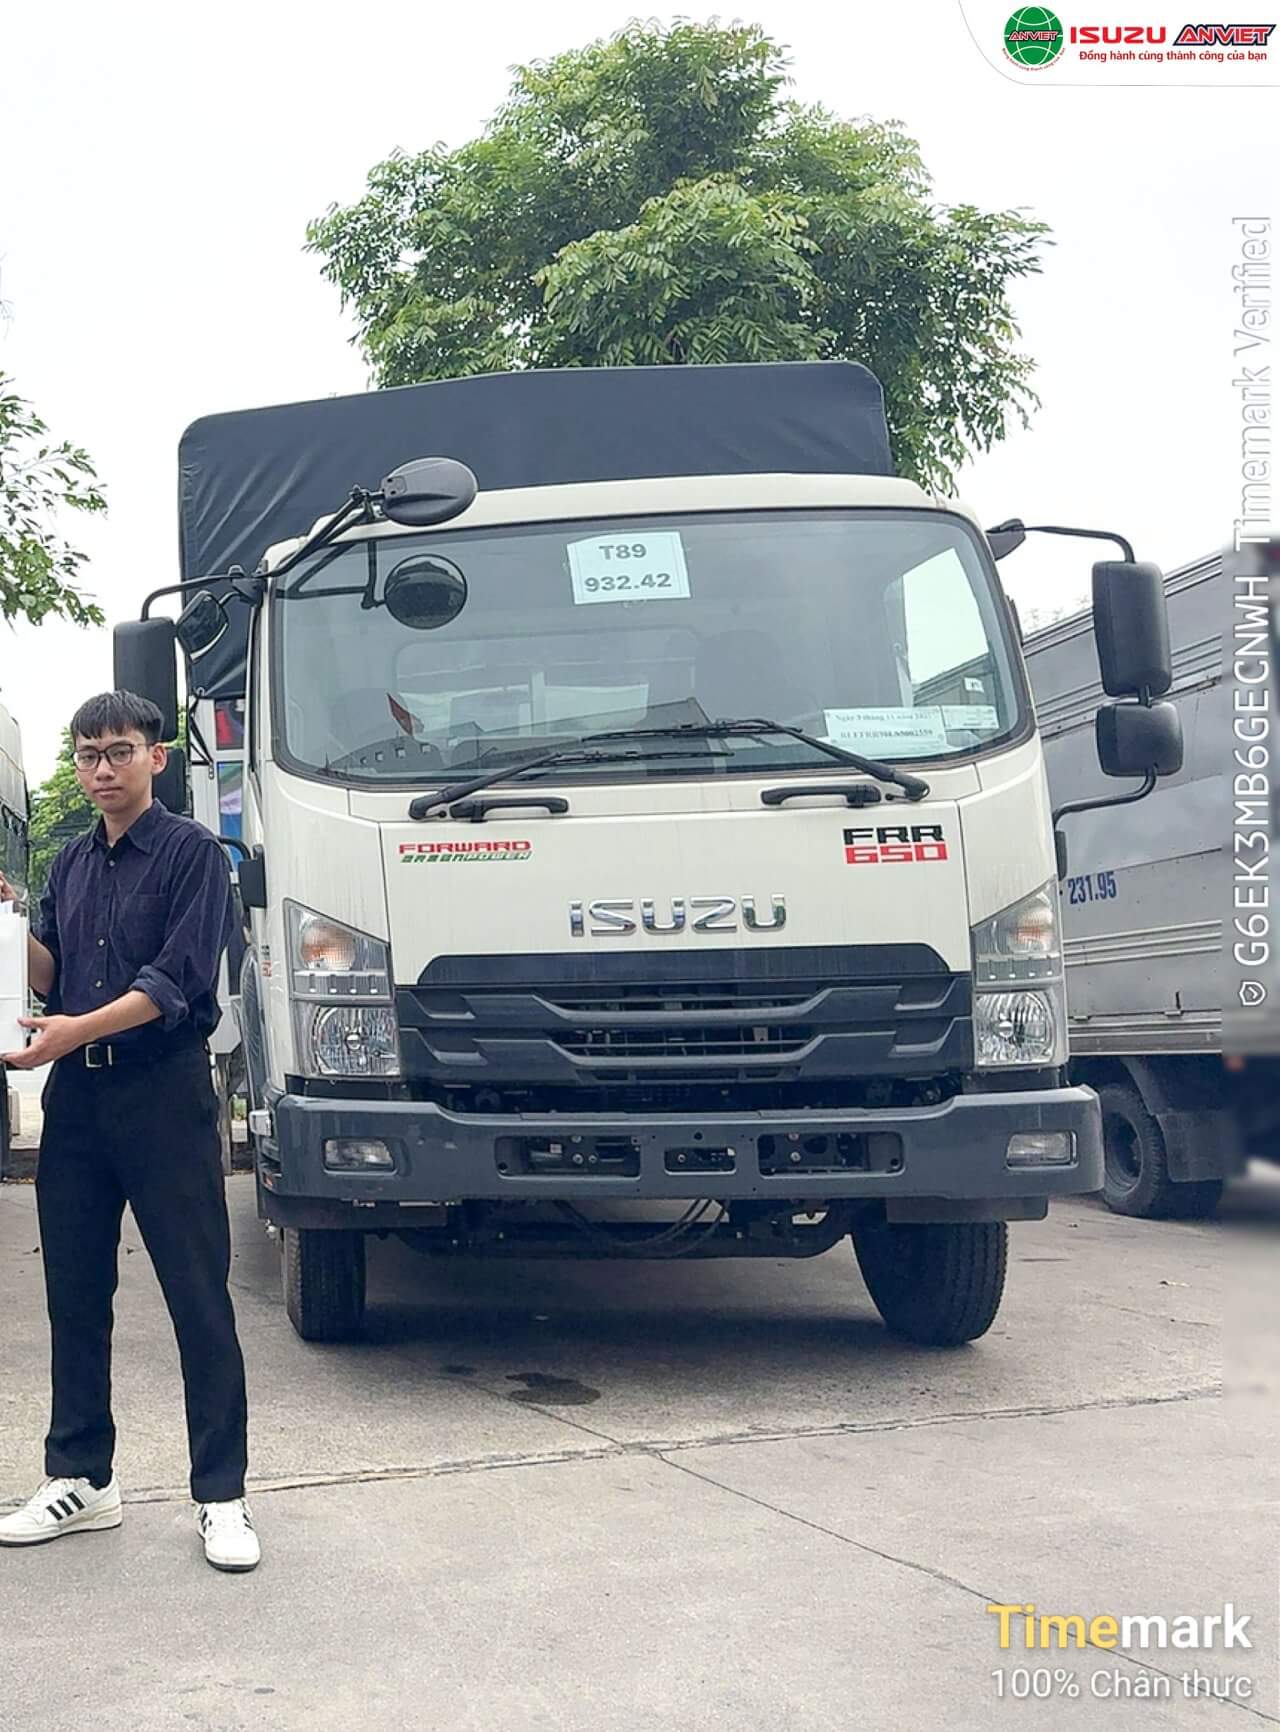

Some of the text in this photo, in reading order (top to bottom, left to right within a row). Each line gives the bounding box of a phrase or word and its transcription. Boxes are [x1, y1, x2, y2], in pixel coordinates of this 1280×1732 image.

[598, 543, 647, 560] T89
[584, 573, 672, 592] 932.42
[843, 824, 945, 845] FRR
[399, 840, 531, 854] FORWARD
[845, 843, 948, 865] 650
[1067, 871, 1117, 904] 231.95
[567, 893, 786, 938] ISUZU
